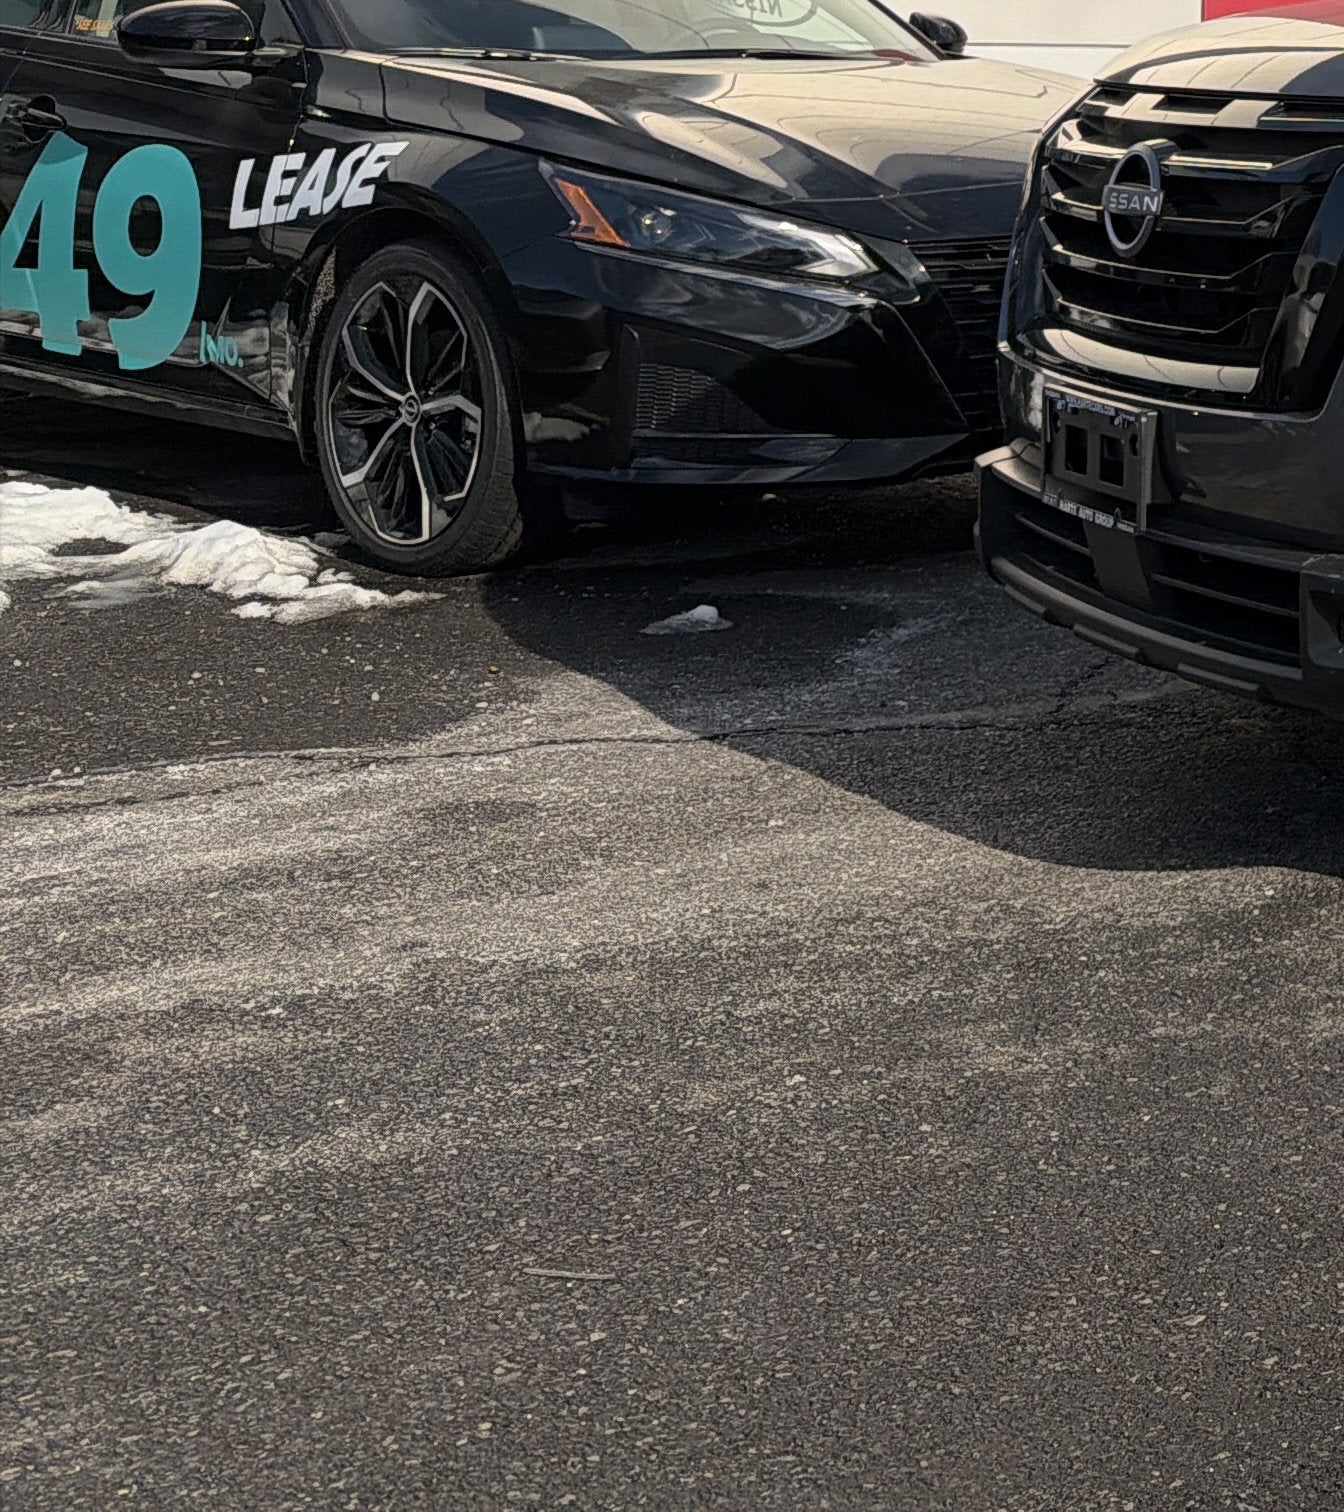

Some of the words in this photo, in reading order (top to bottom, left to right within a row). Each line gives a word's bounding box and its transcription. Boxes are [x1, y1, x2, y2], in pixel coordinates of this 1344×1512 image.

[229, 141, 410, 230] LEASE
[1109, 192, 1159, 212] SSAN
[0, 131, 202, 371] 49
